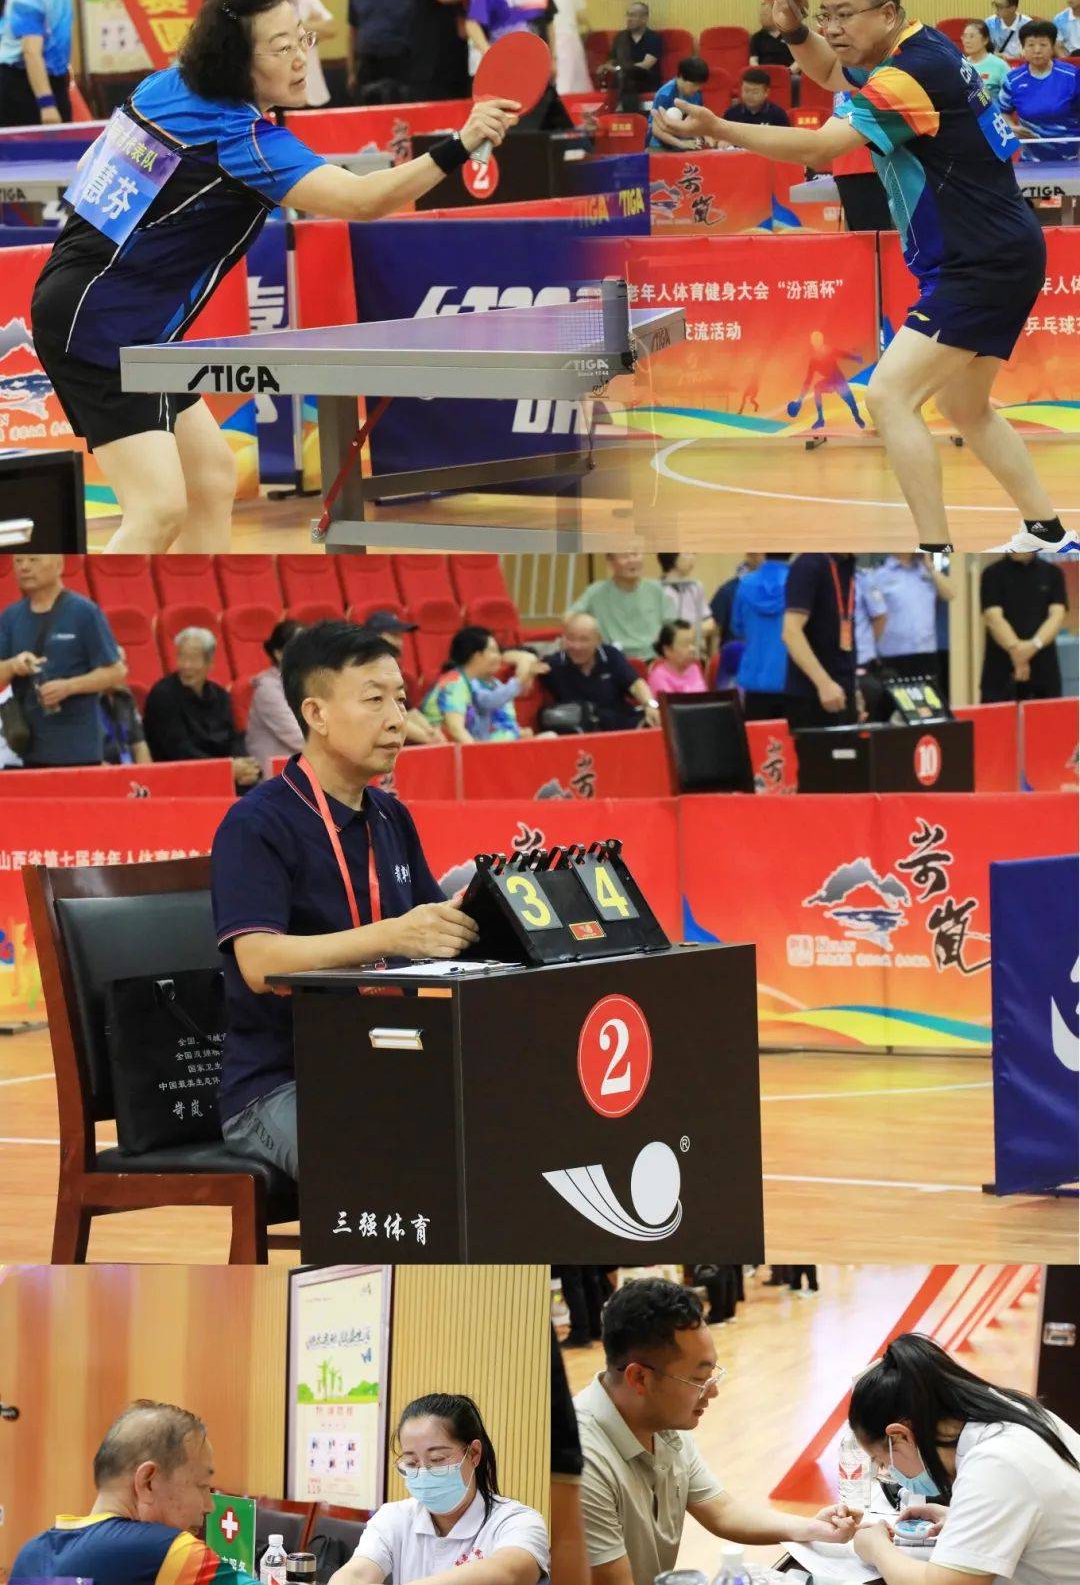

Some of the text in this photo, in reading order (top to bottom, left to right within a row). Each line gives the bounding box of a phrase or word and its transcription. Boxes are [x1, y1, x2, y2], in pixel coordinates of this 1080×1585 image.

[473, 160, 489, 189] 2
[187, 364, 280, 393] STIGA
[561, 358, 610, 371] STIGA
[918, 744, 938, 778] 10
[505, 865, 629, 930] 3 4
[598, 1015, 633, 1096] 2
[332, 1210, 431, 1246] 三强体育
